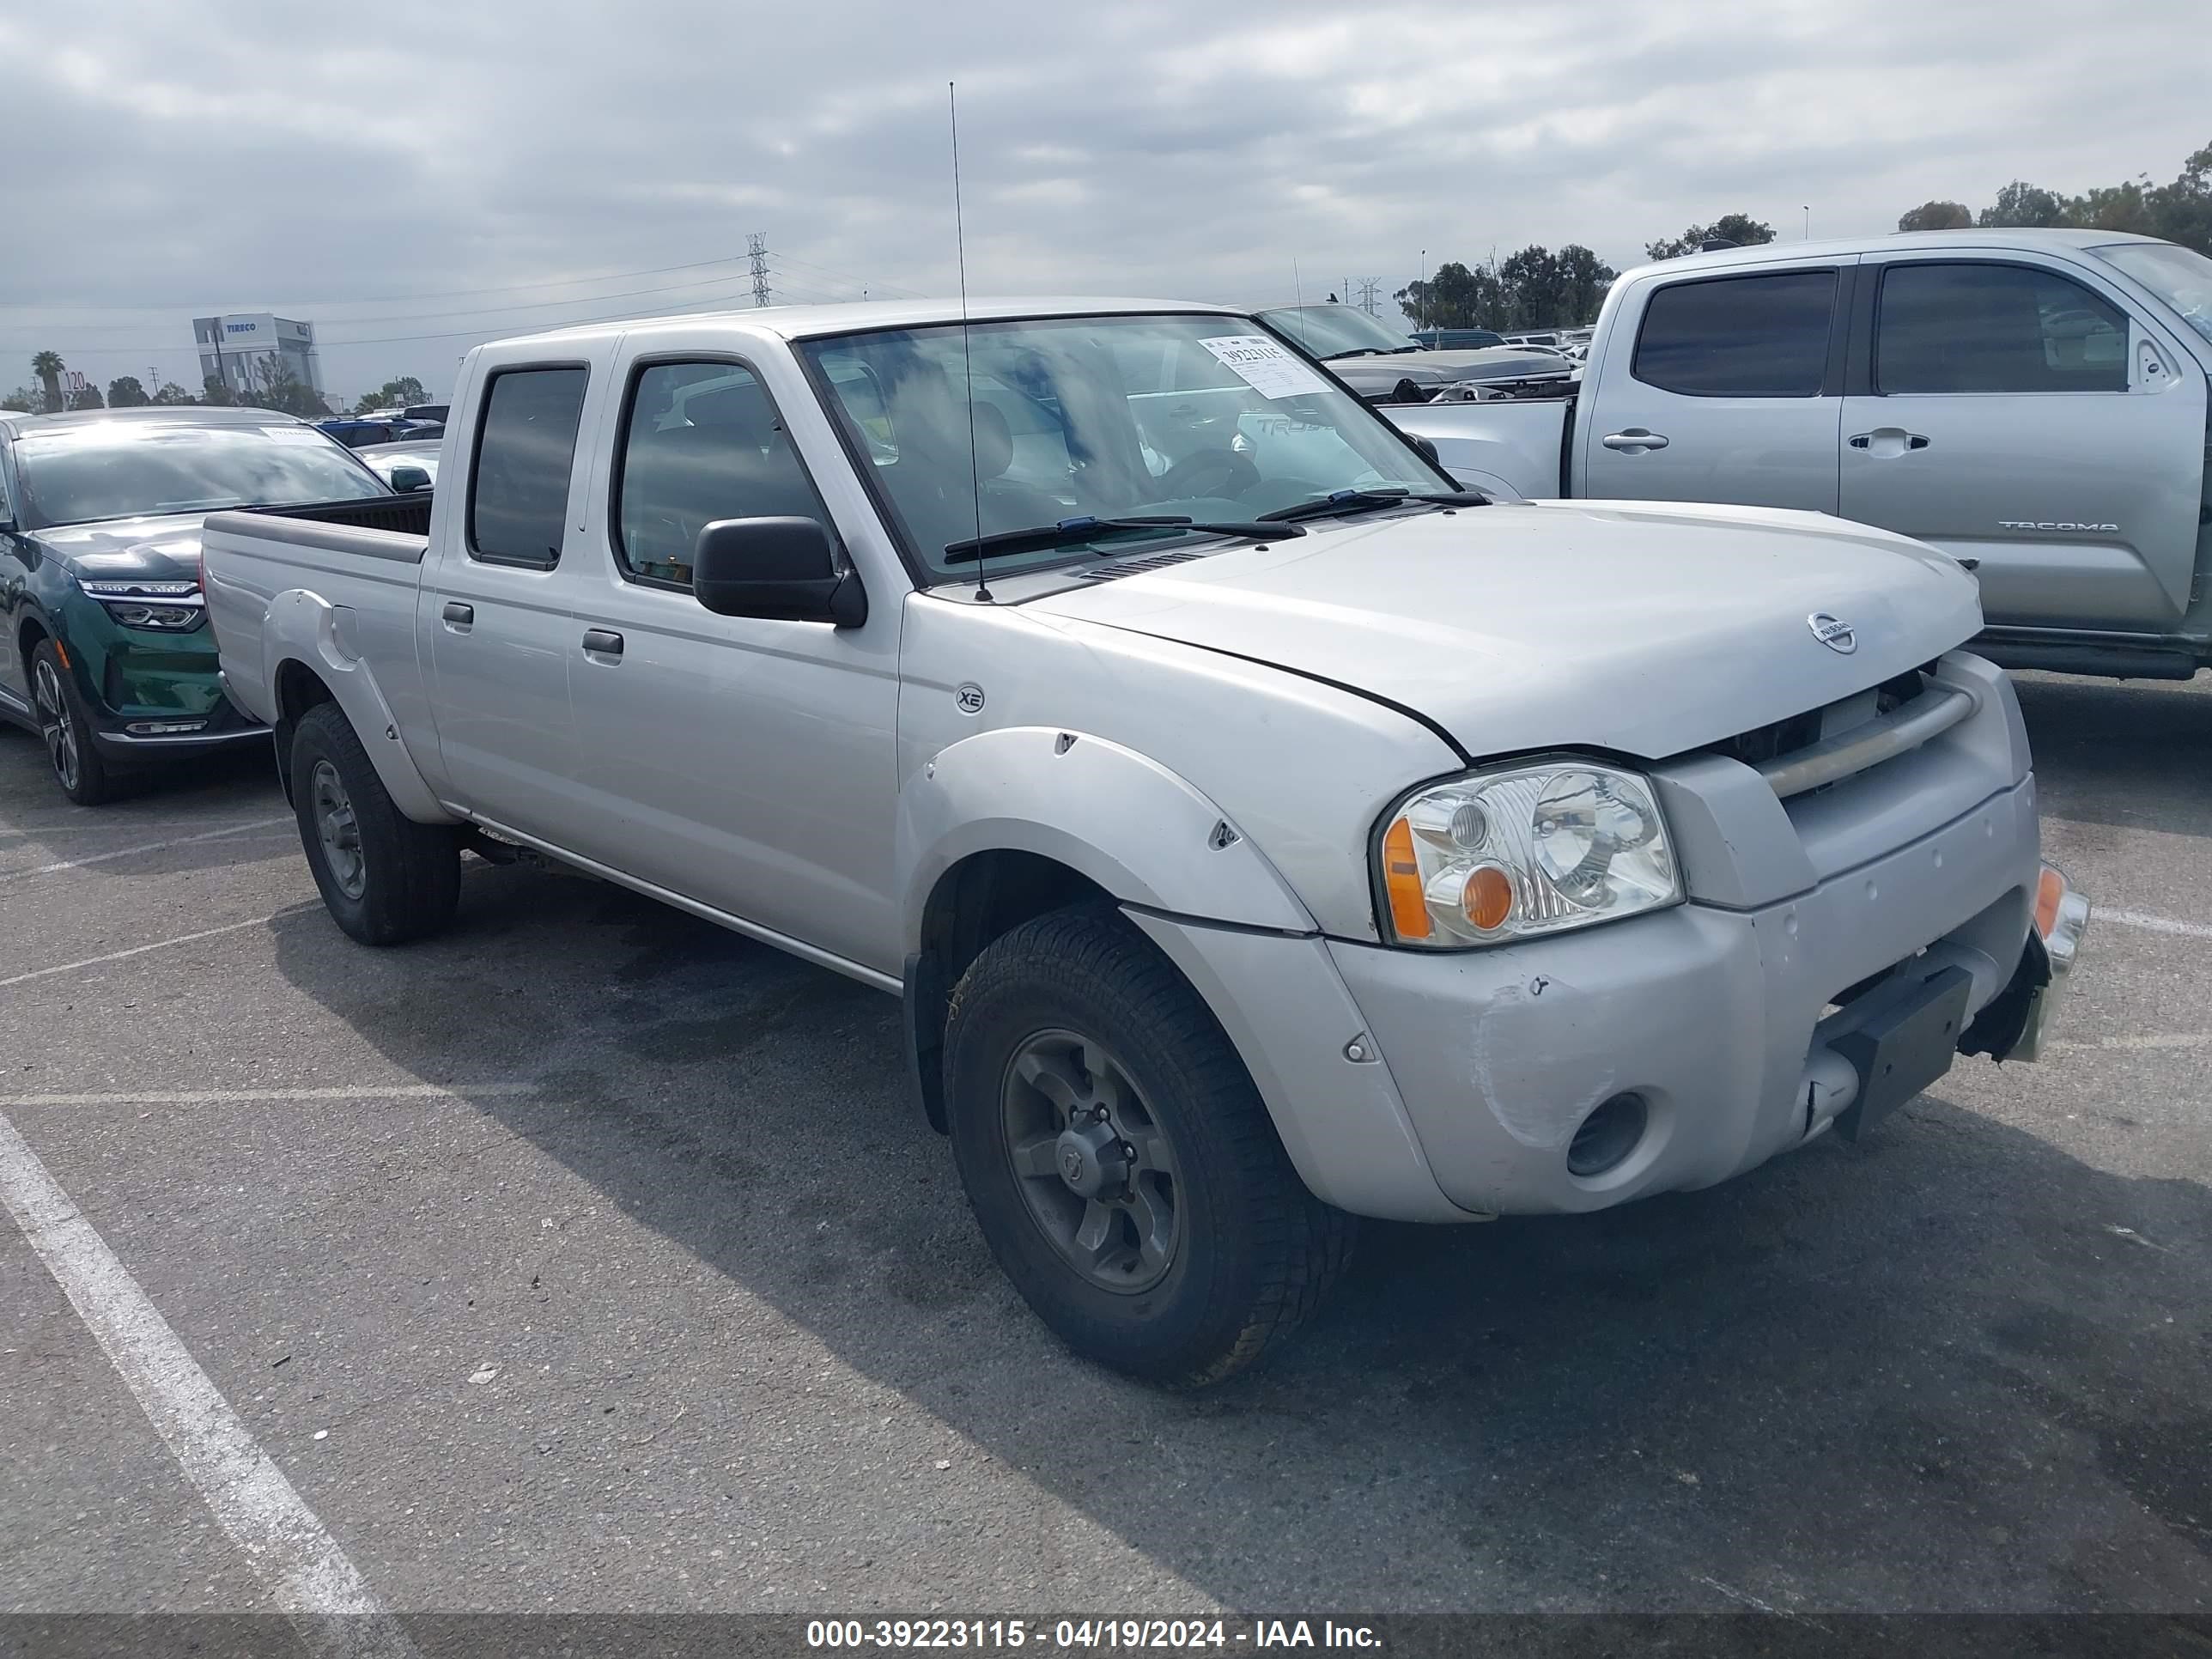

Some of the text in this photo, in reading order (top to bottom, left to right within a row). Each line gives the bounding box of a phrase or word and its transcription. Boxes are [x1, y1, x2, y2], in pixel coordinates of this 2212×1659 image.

[227, 323, 256, 333] TIRECO
[1223, 347, 1284, 363] 39223115
[65, 371, 85, 390] 120
[1998, 521, 2119, 532] TACOMA
[959, 691, 981, 707] XE
